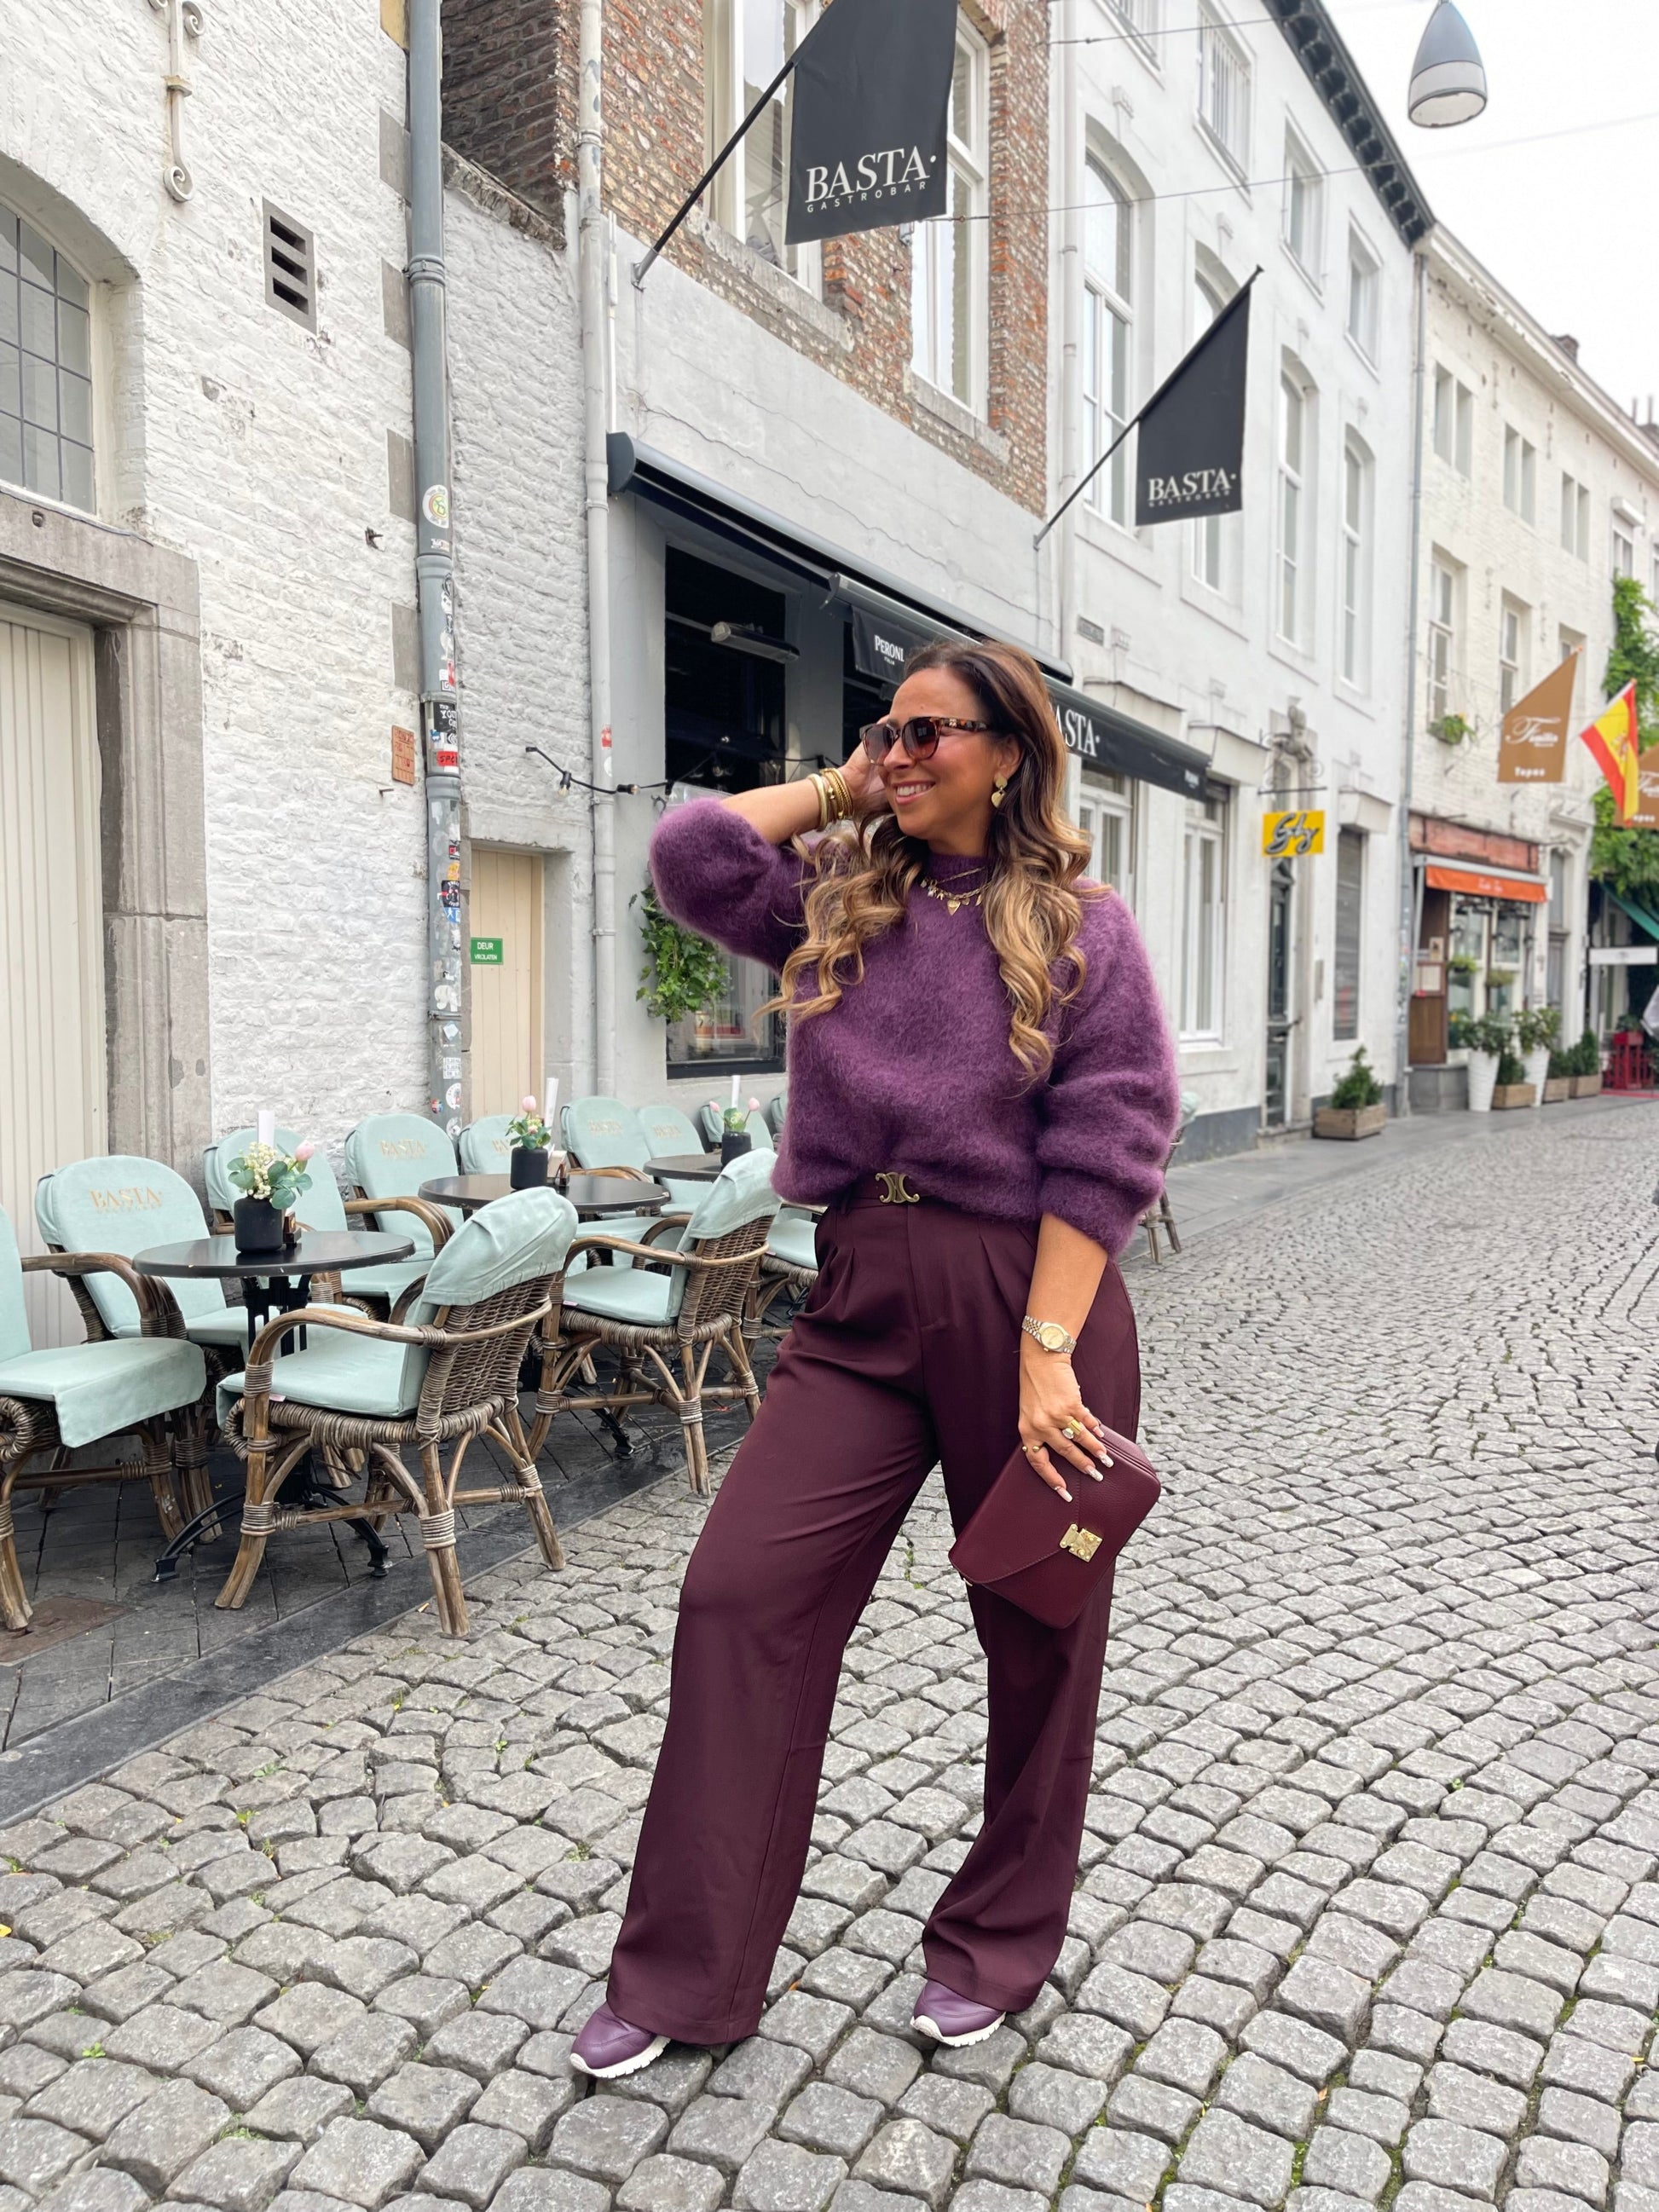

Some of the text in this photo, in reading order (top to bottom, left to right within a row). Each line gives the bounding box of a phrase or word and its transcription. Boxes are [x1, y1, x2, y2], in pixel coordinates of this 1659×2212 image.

[806, 181, 926, 213] GASTROBAR
[874, 634, 905, 662] PERONI
[477, 941, 494, 950] DEUR
